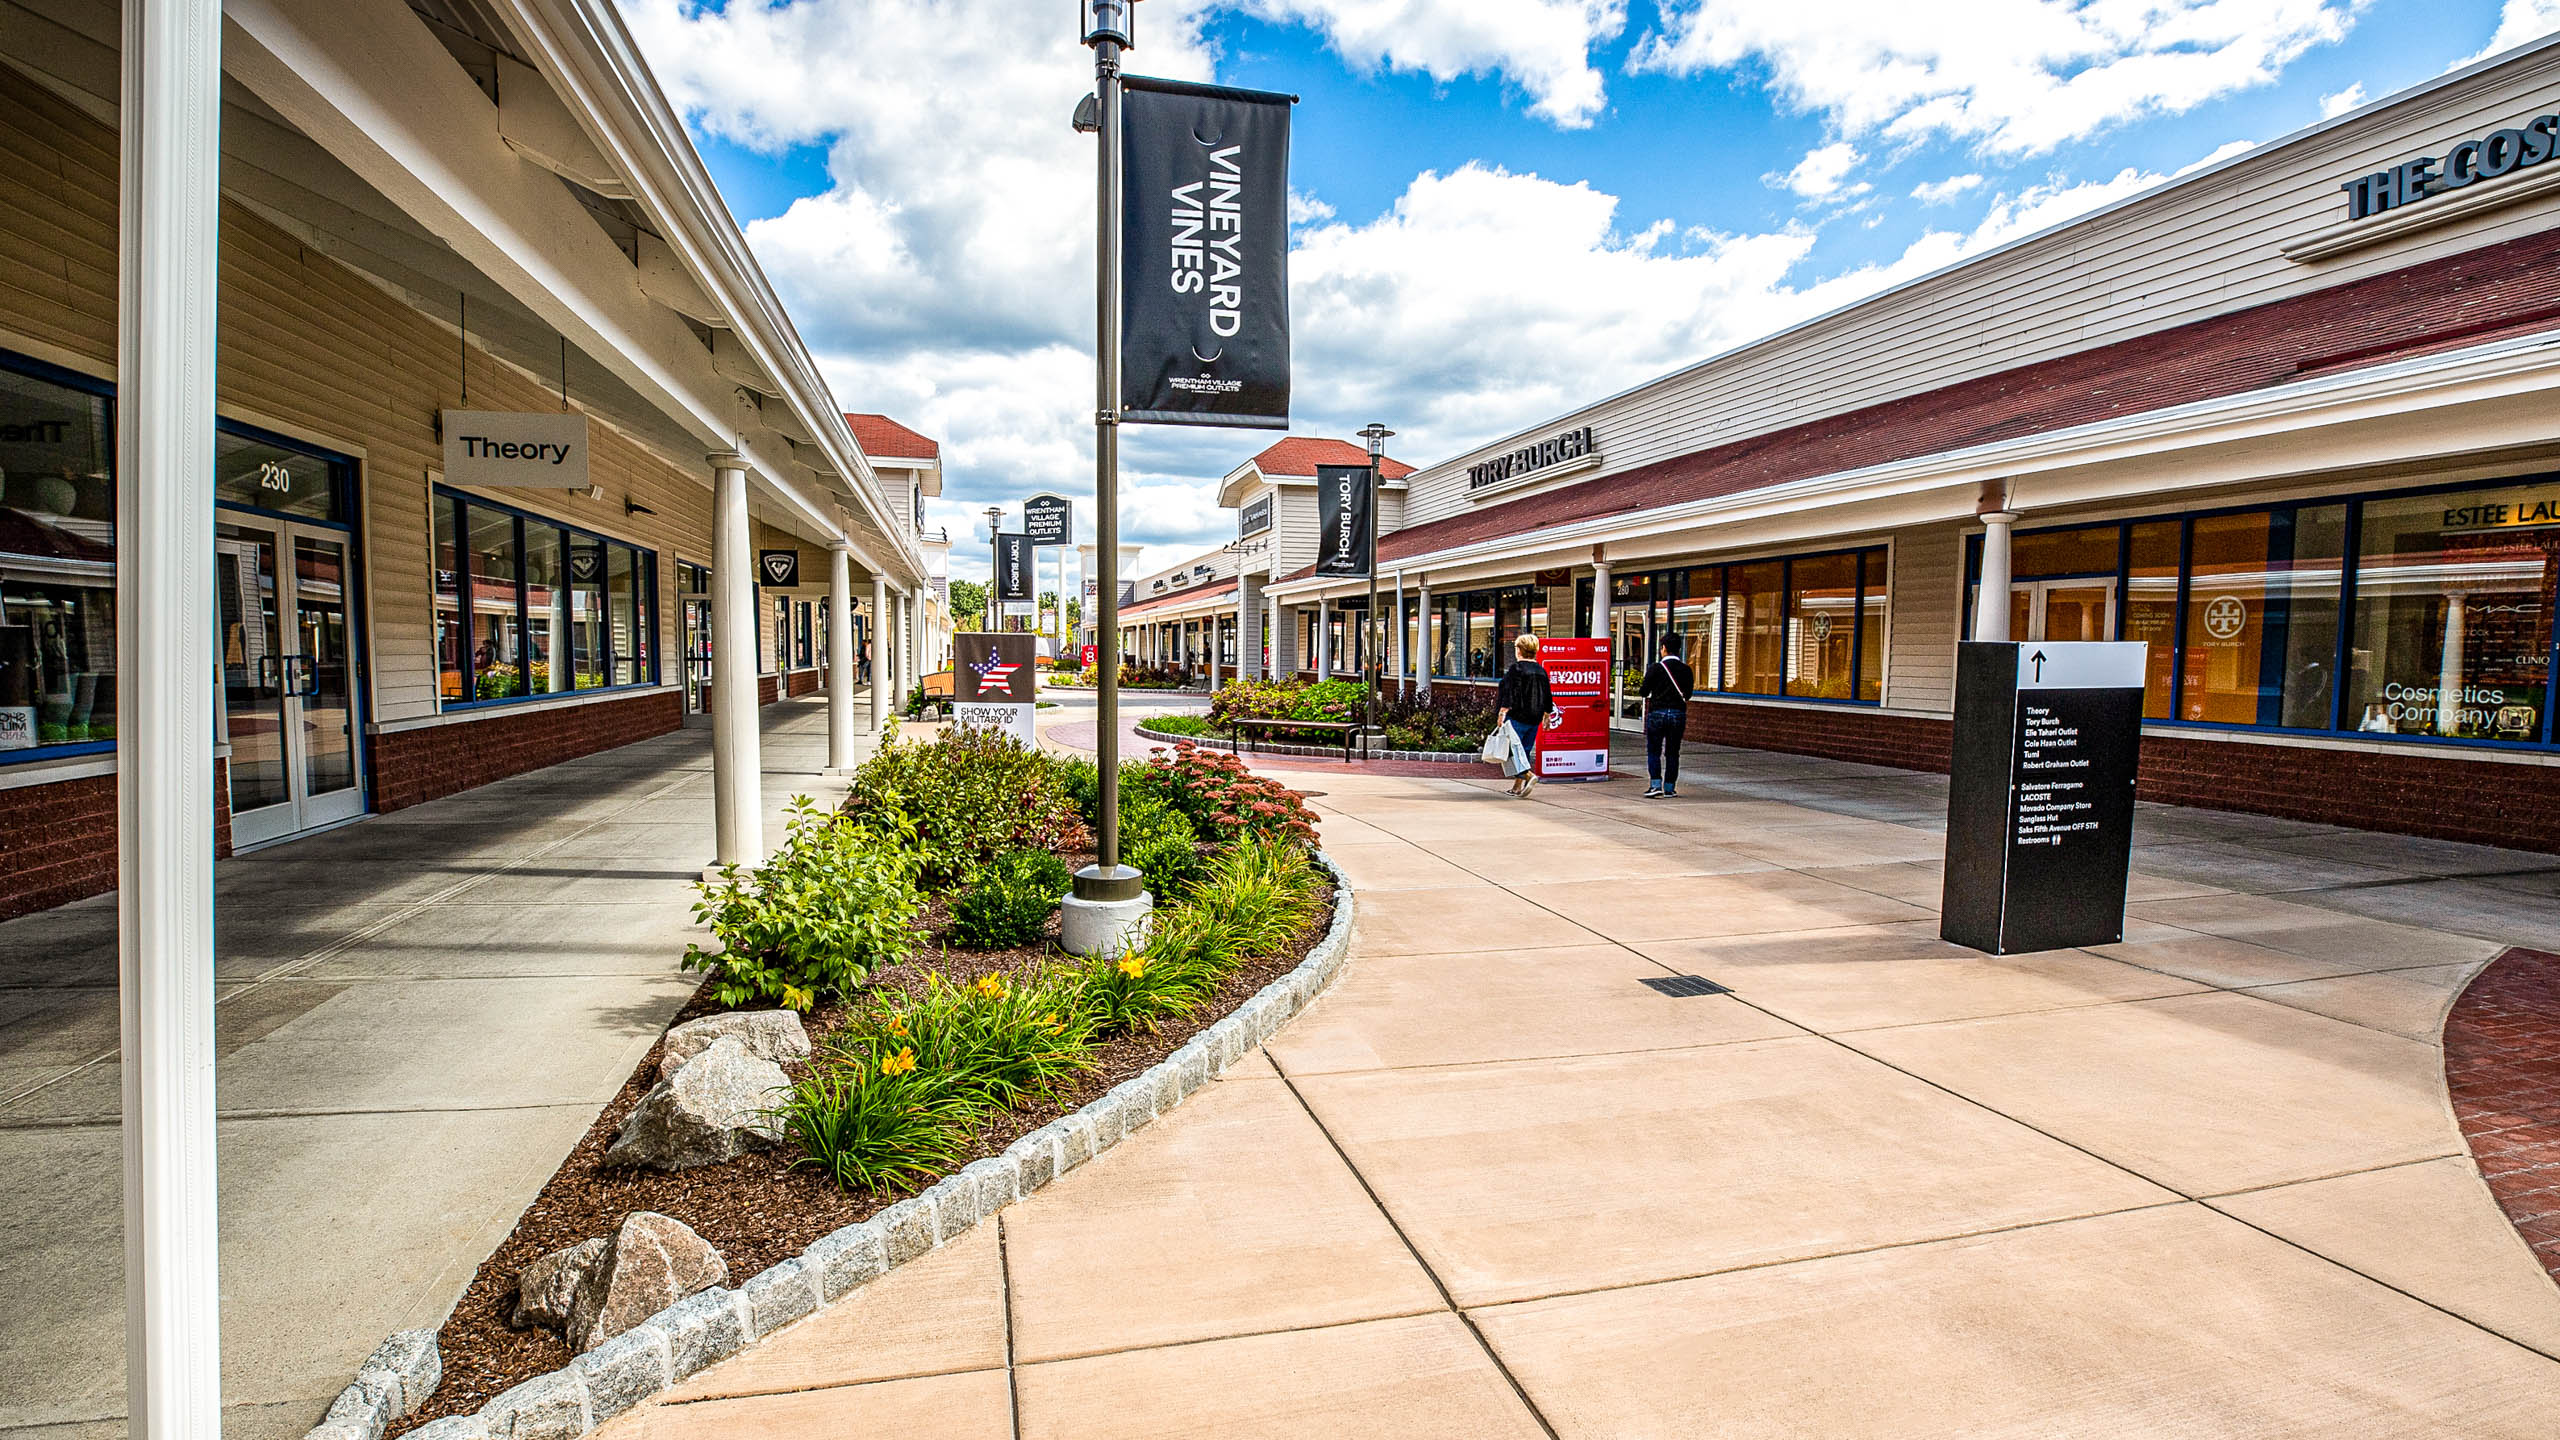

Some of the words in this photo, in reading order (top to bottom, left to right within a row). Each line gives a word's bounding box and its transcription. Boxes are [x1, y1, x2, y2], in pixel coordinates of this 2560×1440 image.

[2340, 157, 2435, 220] THE
[2443, 111, 2560, 188] COS
[1171, 182, 1204, 294] VINES
[1210, 145, 1241, 337] VINEYARD
[459, 436, 570, 465] Theory
[1467, 453, 1514, 490] TORY
[1515, 427, 1592, 476] BURCH
[261, 463, 290, 493] 230
[1338, 474, 1350, 511] TORY
[1026, 506, 1065, 514] WRENTHAM
[1338, 513, 1350, 558] BURCH
[1011, 540, 1020, 562] TORY
[1011, 562, 1020, 591] BURCH
[2385, 682, 2504, 704] Cosmetics
[961, 708, 992, 716] SHOW
[993, 708, 1018, 716] YOUR
[961, 716, 1002, 724] MILITARY
[2026, 706, 2050, 716] Theory
[2026, 718, 2040, 726] Tory
[2041, 717, 2060, 725] Burch
[2388, 702, 2498, 730] Company
[2051, 782, 2083, 790] Ferragamo
[2046, 803, 2074, 812] Company
[2018, 826, 2033, 834] Saks
[2019, 816, 2046, 824] Sunglass
